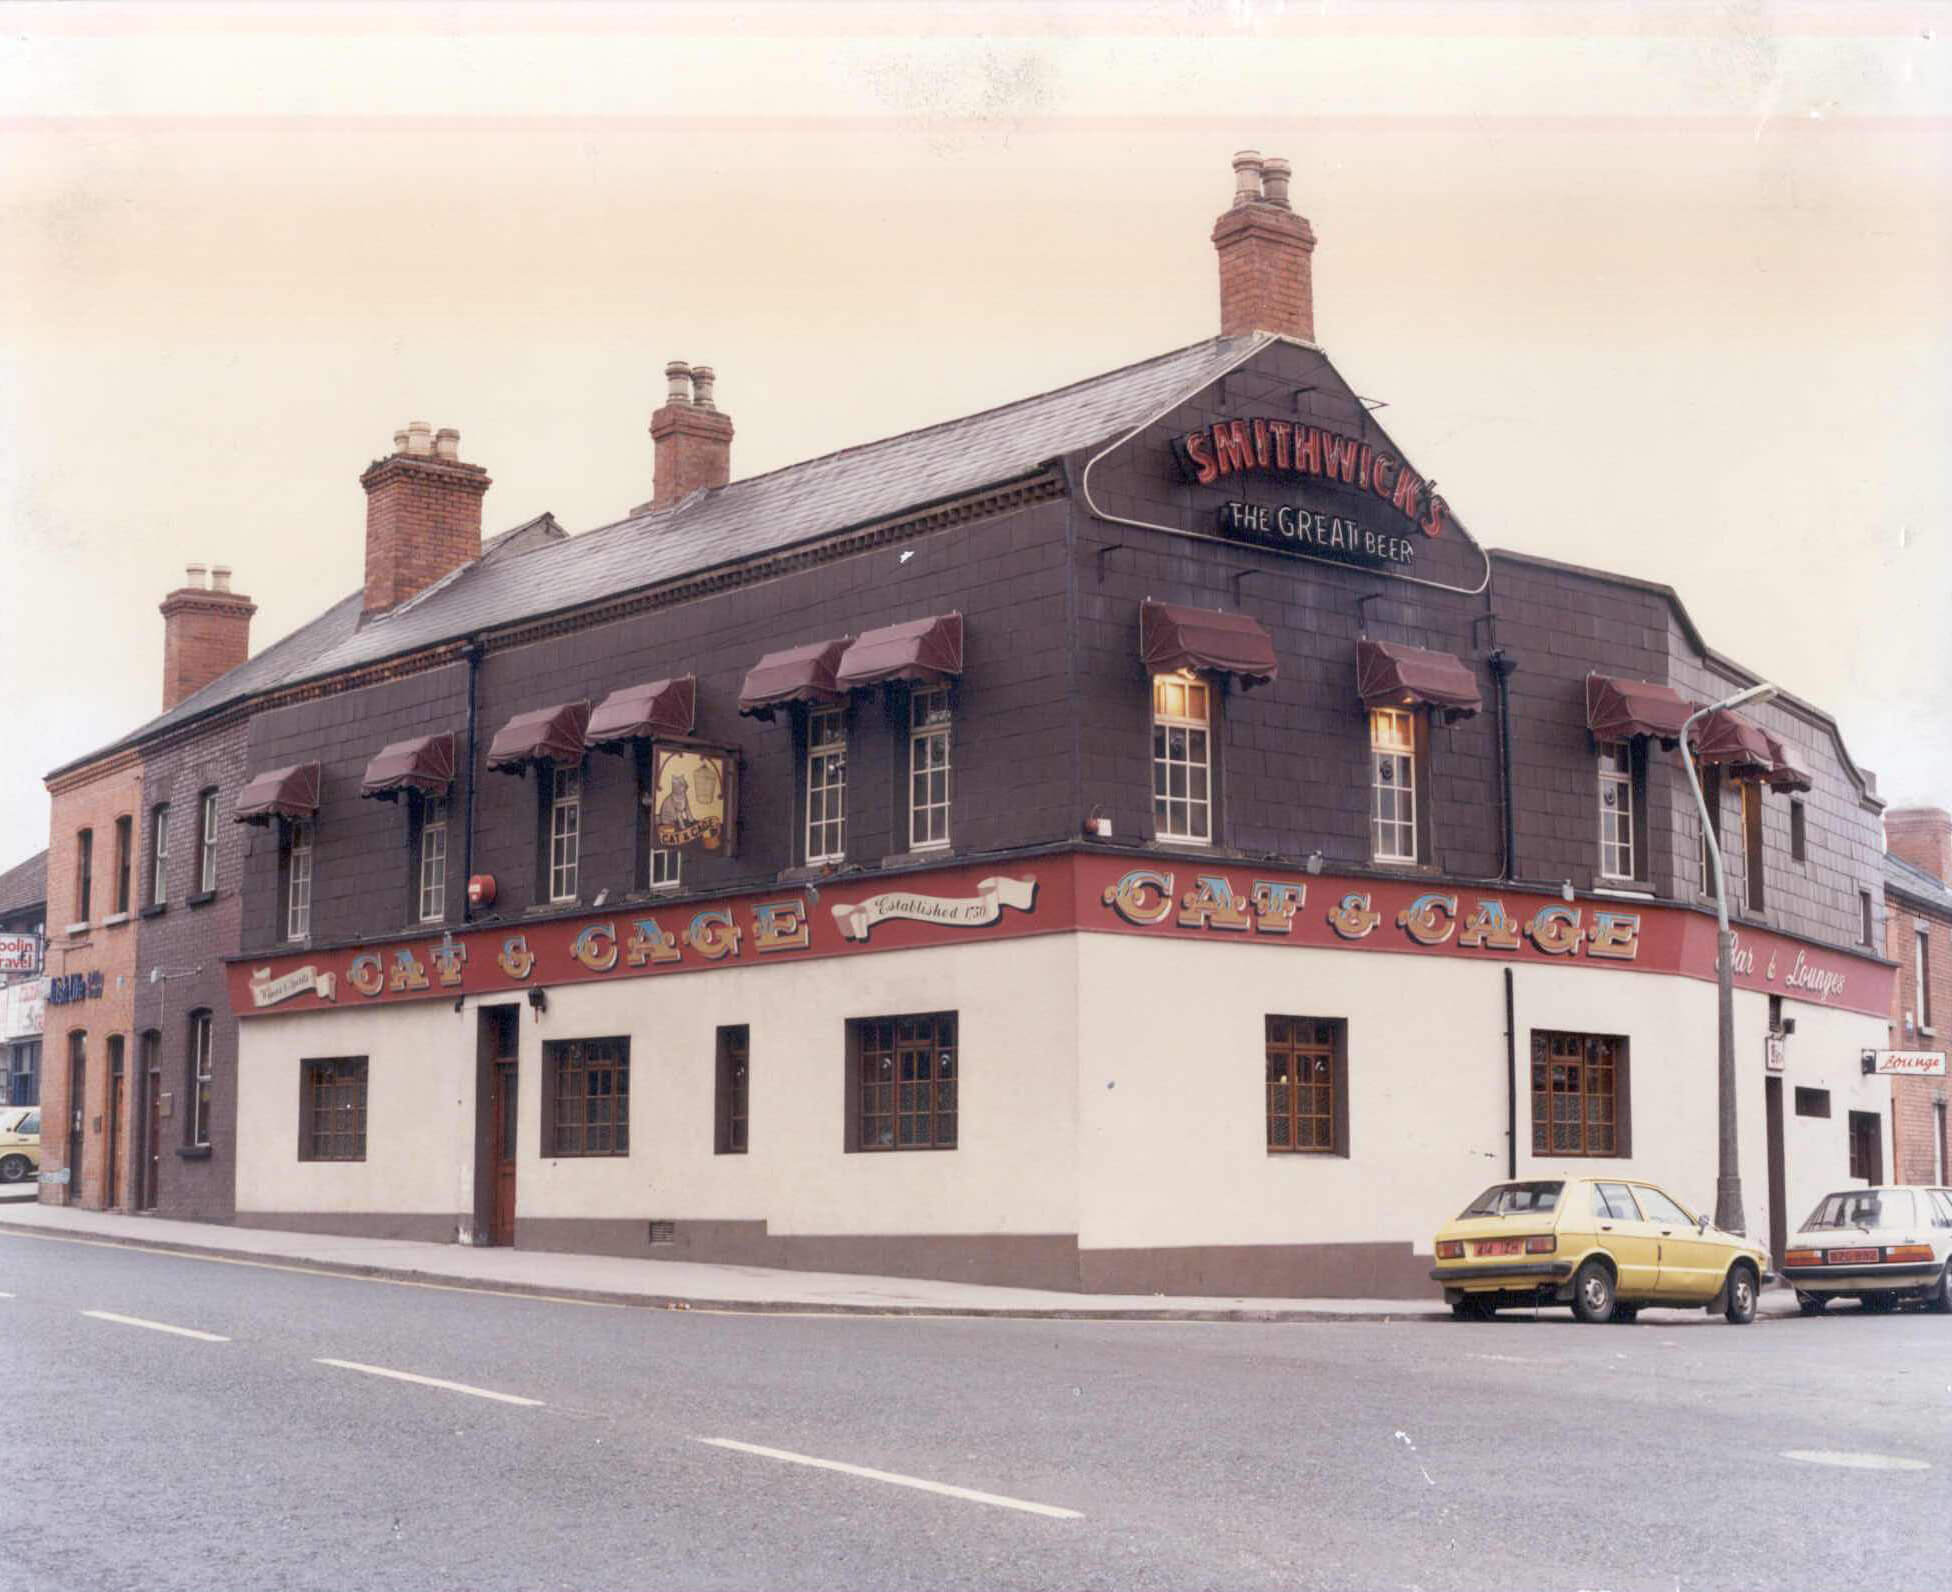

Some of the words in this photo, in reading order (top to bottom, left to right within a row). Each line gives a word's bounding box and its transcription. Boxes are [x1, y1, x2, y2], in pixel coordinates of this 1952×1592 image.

[1186, 417, 1450, 538] SMITHWICK'S
[1229, 502, 1270, 532] THE
[1278, 506, 1359, 550] GREAT
[1365, 531, 1414, 564] BEER
[874, 896, 958, 920] Established
[1103, 869, 1307, 934] CAT
[1327, 892, 1381, 940] &
[1395, 893, 1641, 961] CAGE
[346, 940, 467, 996] CAT
[498, 935, 535, 980] &
[569, 898, 809, 972] CAGE
[1785, 949, 1846, 1000] Lounges
[1880, 1055, 1940, 1071] Lounge
